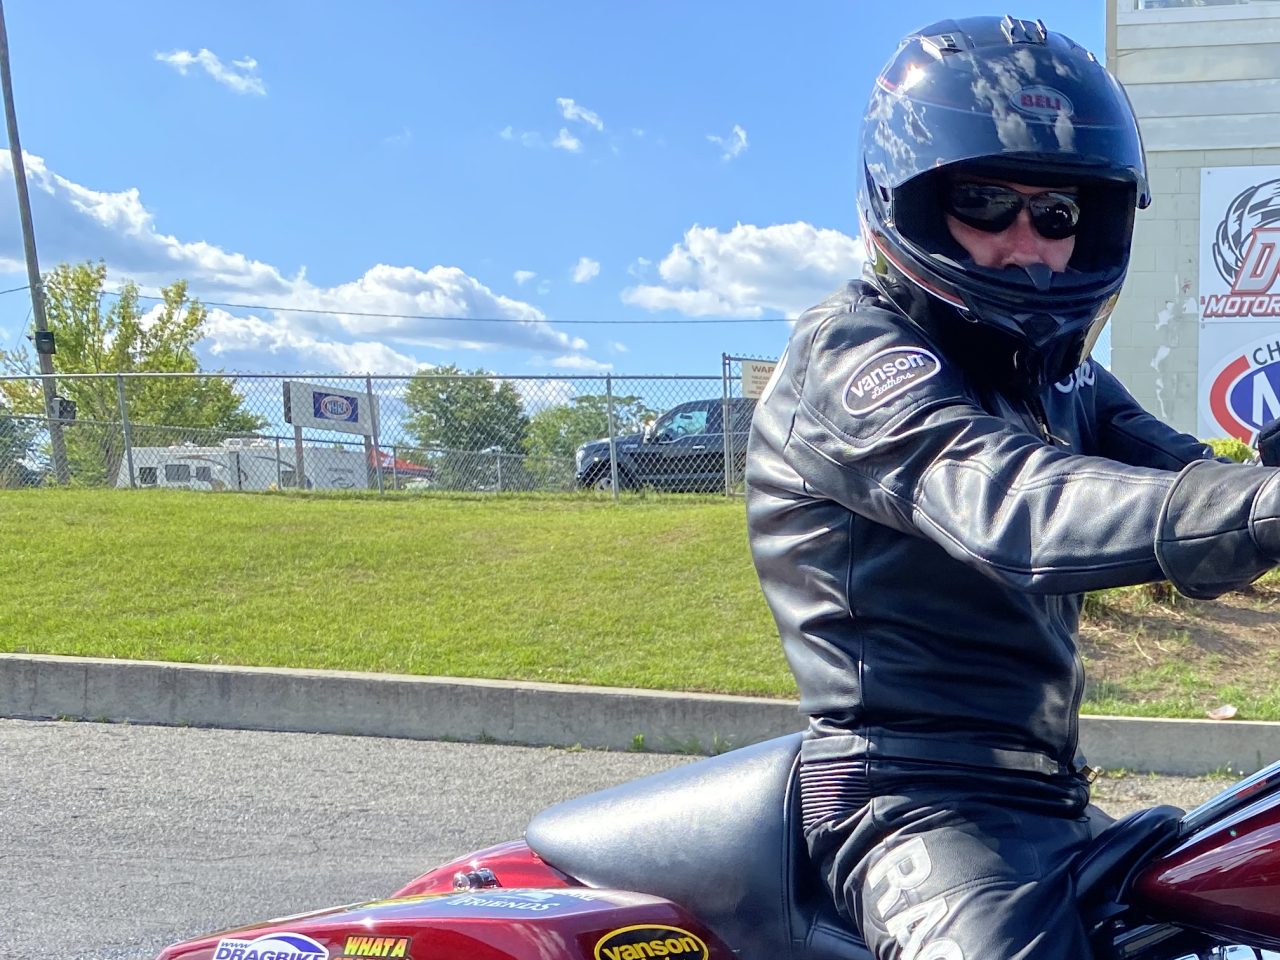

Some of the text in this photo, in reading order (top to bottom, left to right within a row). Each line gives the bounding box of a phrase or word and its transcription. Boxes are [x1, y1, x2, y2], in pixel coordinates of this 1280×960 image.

[1021, 94, 1061, 110] BELL
[851, 354, 926, 398] vanson
[871, 372, 916, 400] Leathers
[344, 936, 408, 957] WHAT A
